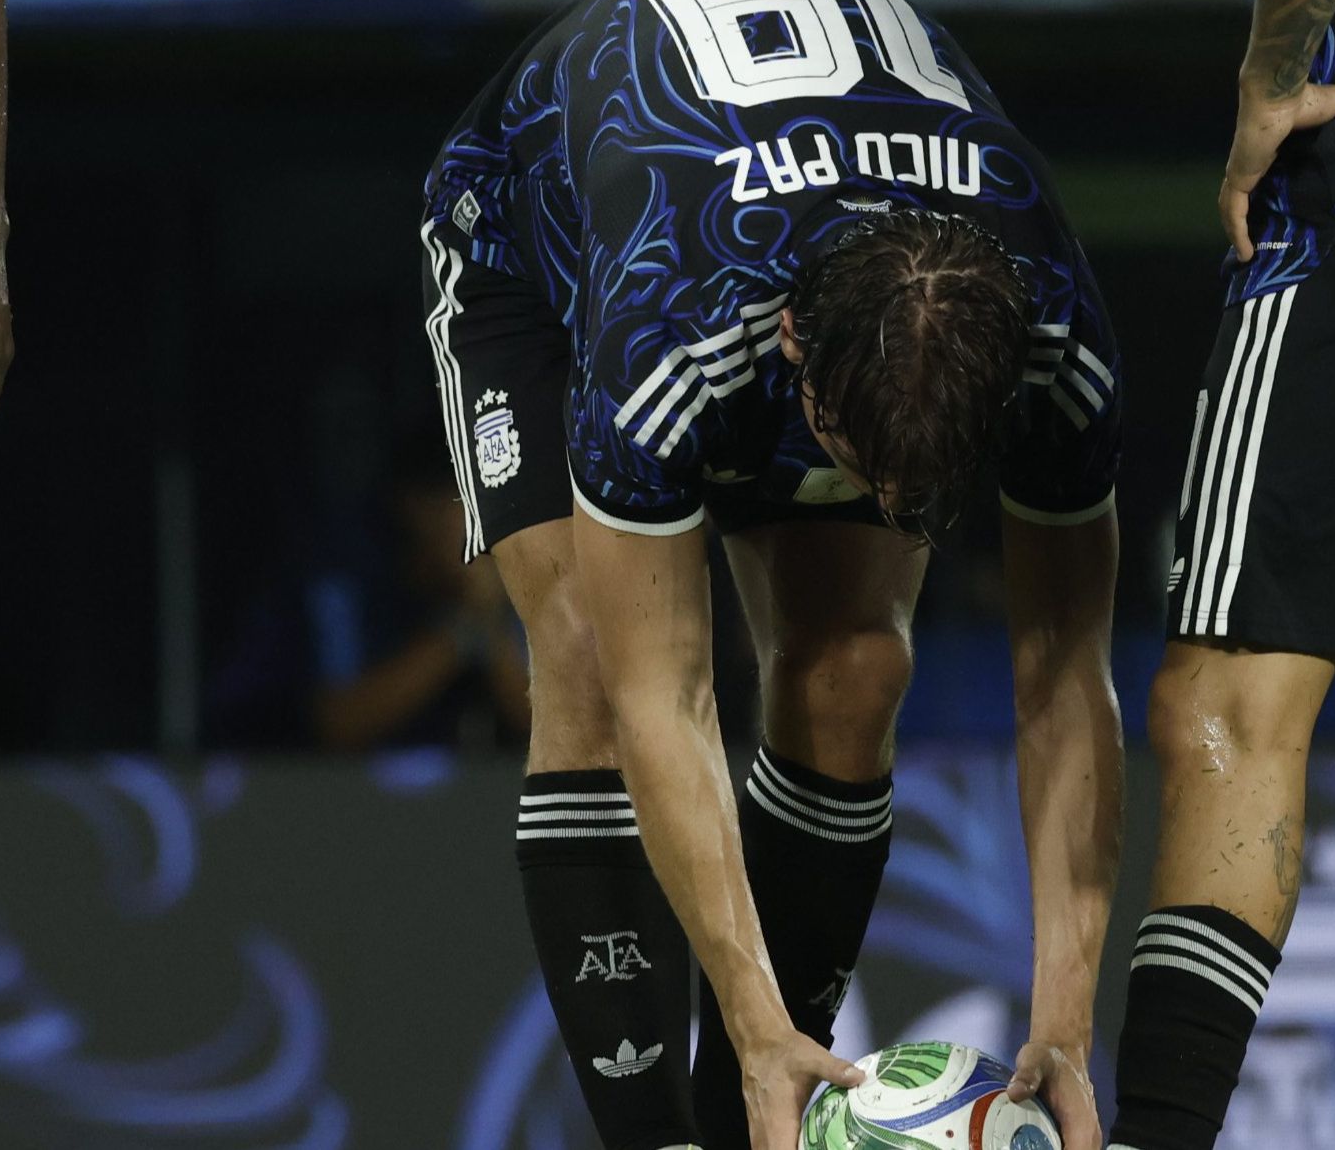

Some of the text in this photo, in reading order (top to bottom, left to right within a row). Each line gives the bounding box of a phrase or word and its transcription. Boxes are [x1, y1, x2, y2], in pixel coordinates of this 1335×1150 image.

[714, 132, 981, 204] NICO PAZ
[483, 430, 508, 464] AFA
[575, 930, 652, 983] AFA
